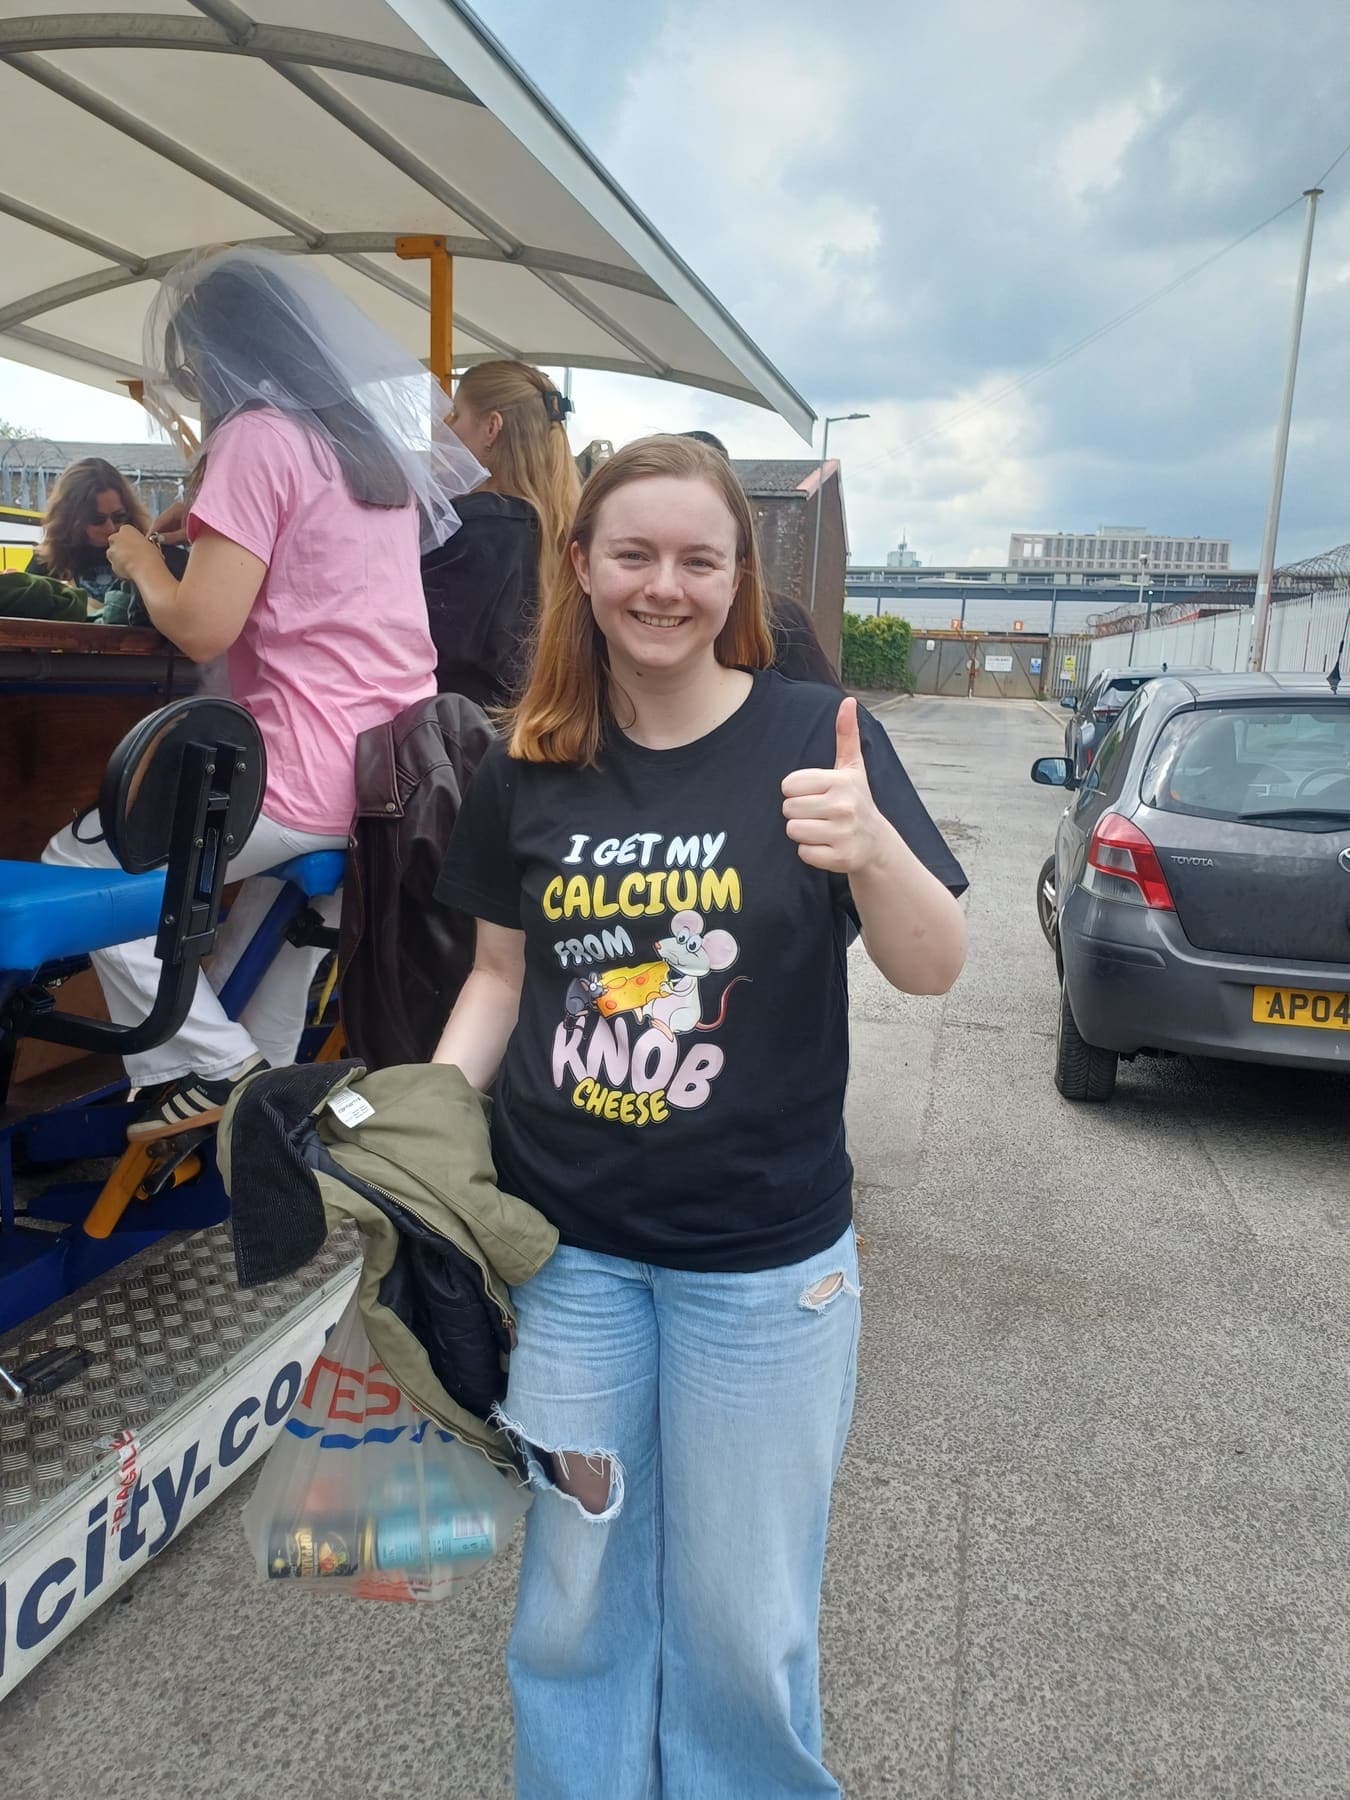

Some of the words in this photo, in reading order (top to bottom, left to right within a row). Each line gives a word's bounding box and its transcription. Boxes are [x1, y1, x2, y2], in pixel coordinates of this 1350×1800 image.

[562, 833, 591, 864] I
[593, 832, 663, 867] GET
[666, 832, 726, 868] MY
[1170, 855, 1214, 867] TOYOTA
[542, 867, 741, 920] CALCIUM
[554, 925, 634, 968] FROM
[1268, 992, 1350, 1025] AP04
[552, 1016, 726, 1110] KNOB
[572, 1077, 670, 1127] CHEESE
[302, 1355, 420, 1424] TES
[0, 1322, 337, 1677] city.co
